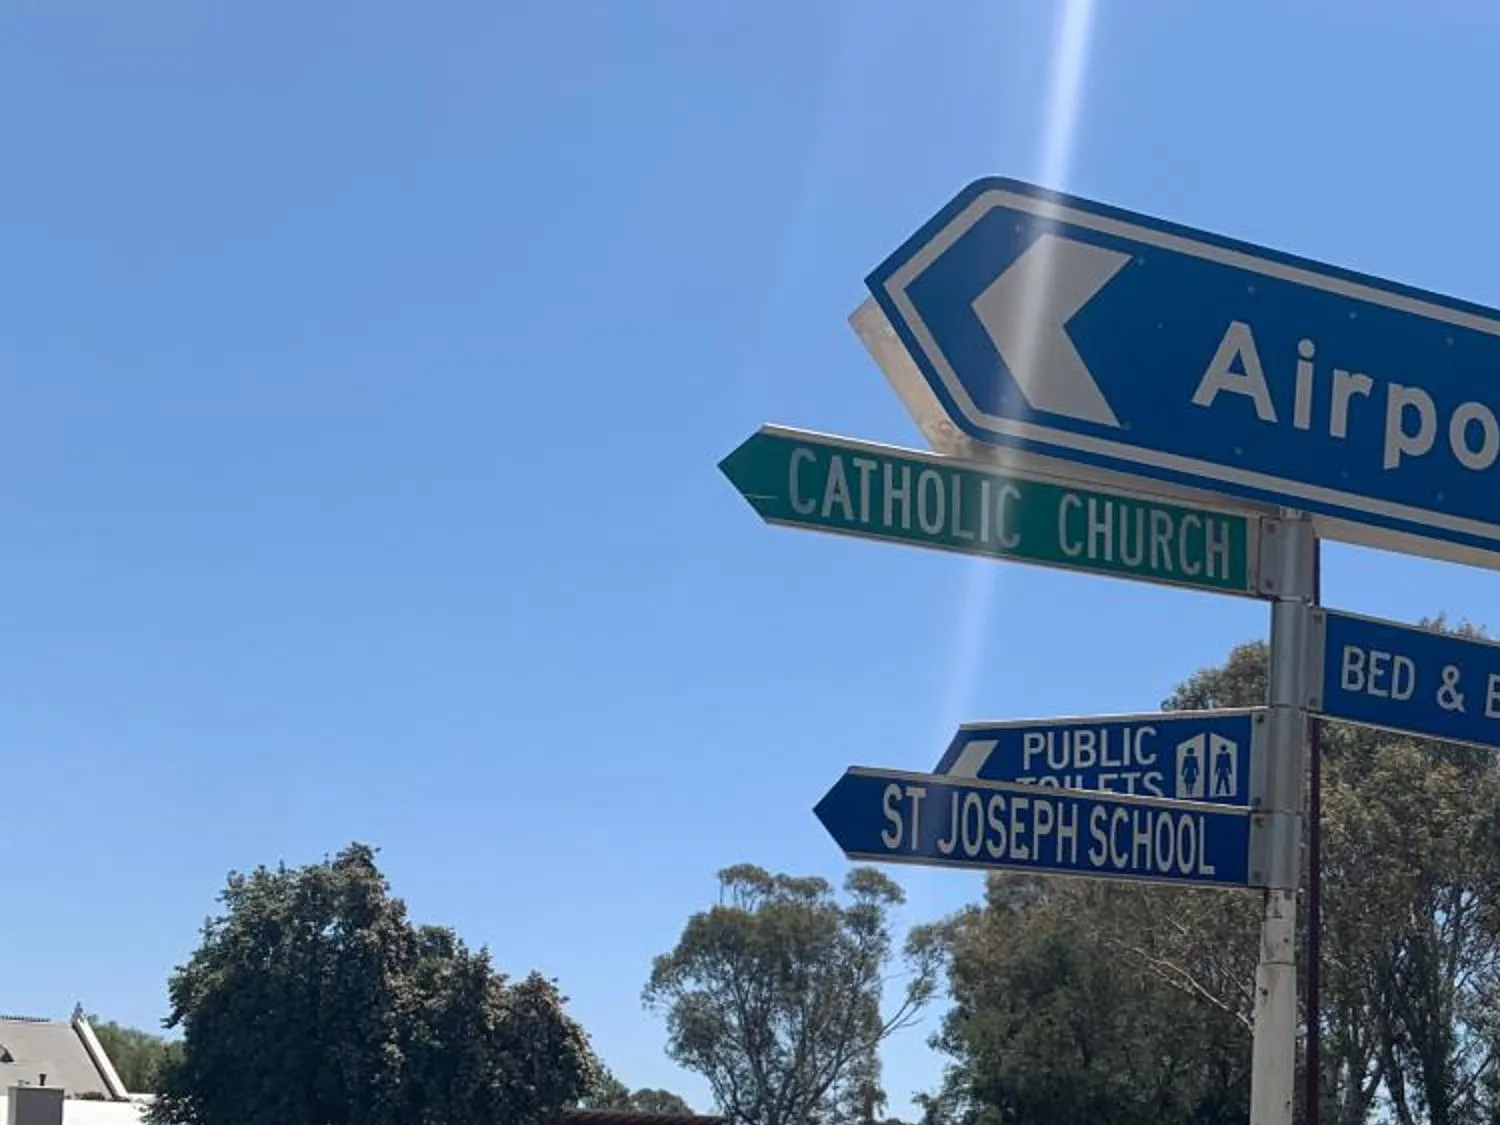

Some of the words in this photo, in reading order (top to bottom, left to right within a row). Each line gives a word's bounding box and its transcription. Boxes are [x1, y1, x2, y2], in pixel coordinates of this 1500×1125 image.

[788, 447, 1021, 548] CATHOLIC
[1058, 492, 1230, 581] CHURCH
[1341, 643, 1415, 701] BED
[1435, 664, 1465, 714] &
[1023, 725, 1157, 770] PUBLIC
[881, 783, 926, 850] ST
[937, 791, 1077, 864] JOSEPH
[1088, 807, 1215, 875] SCHOOL
